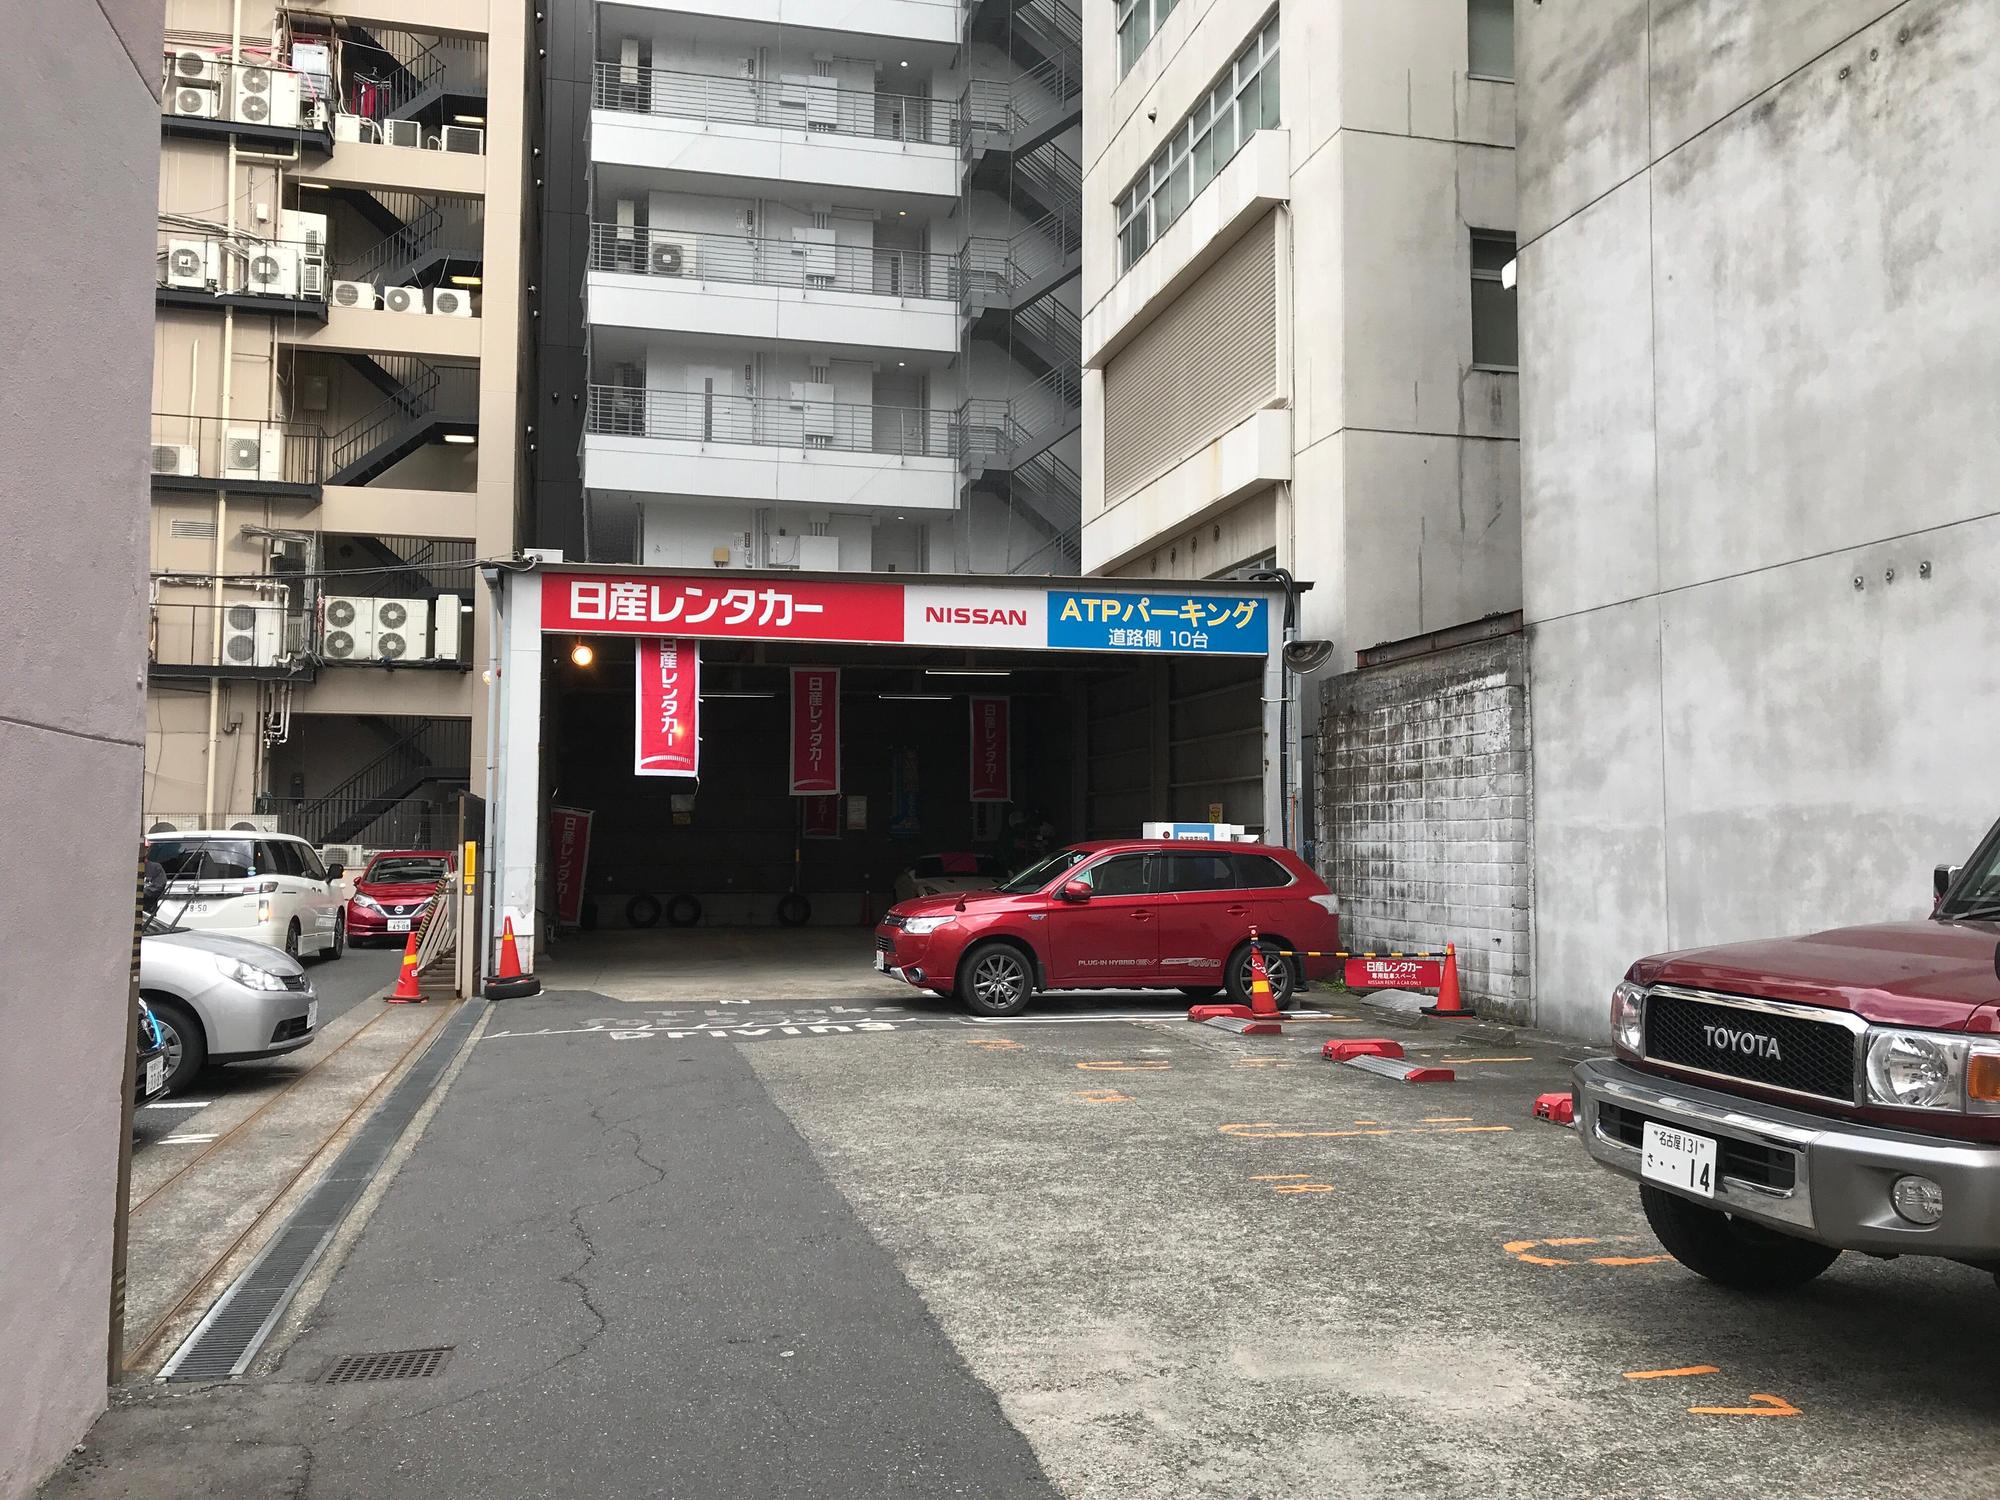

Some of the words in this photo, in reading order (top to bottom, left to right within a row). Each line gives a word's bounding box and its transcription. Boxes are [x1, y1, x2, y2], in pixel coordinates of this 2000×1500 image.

[570, 581, 824, 627] 日産レンタカー
[925, 606, 1028, 626] NISSAN
[1060, 597, 1258, 629] ATPパーキング
[1108, 628, 1162, 648] 道路側
[1170, 630, 1209, 650] 10台
[660, 638, 678, 747] 日産レンタカー
[808, 677, 823, 772] 日産レンタカー
[984, 704, 997, 783] 日産レンタカー
[557, 817, 577, 905] 日産レンタカー
[1366, 961, 1423, 972] 日産レンタカー
[1703, 1025, 1781, 1060] TOYOTA
